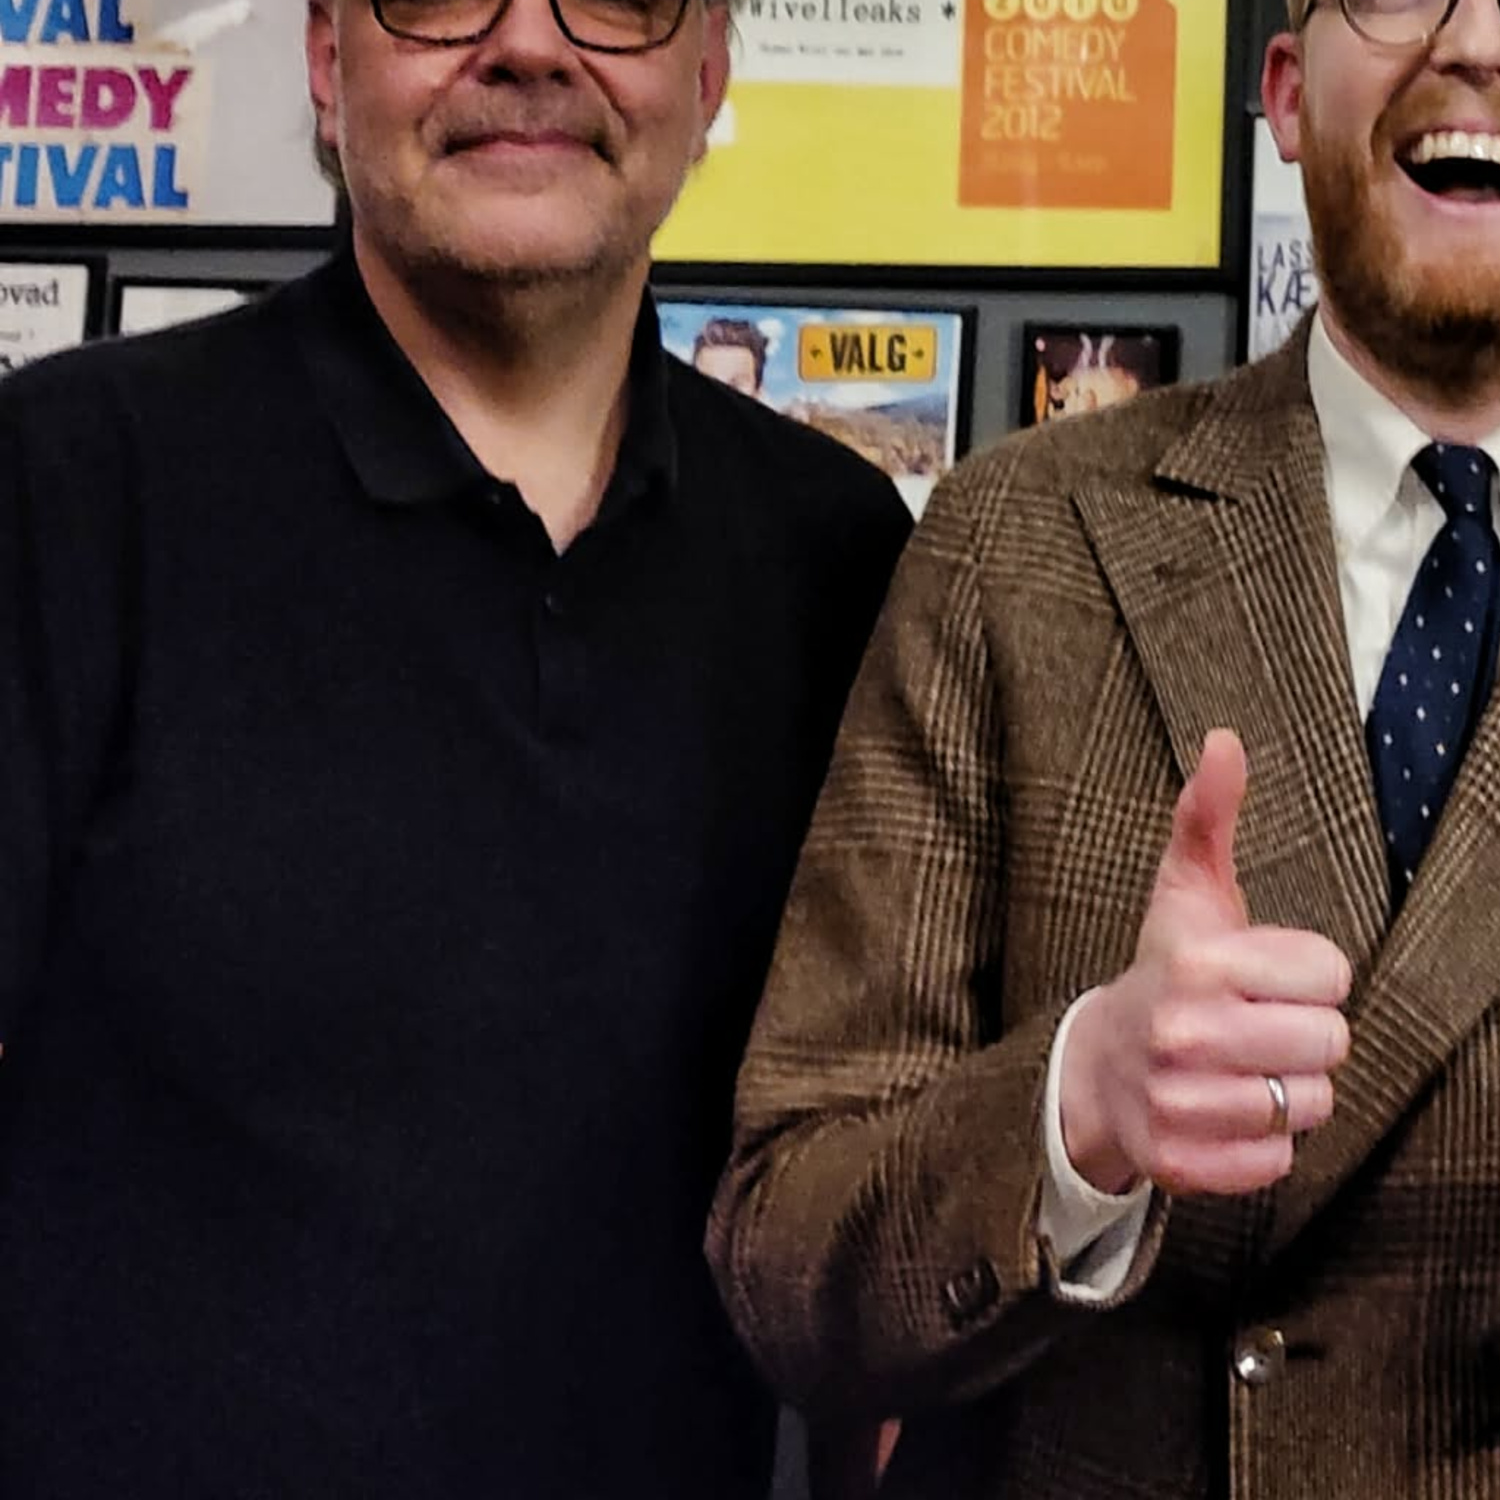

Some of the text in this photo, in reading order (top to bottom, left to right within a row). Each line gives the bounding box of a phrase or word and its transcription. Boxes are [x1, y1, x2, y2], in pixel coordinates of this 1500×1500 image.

[984, 25, 1126, 63] COMEDY
[984, 65, 1137, 102] FESTIVAL
[979, 104, 1063, 141] 2012
[829, 333, 908, 374] VALG
